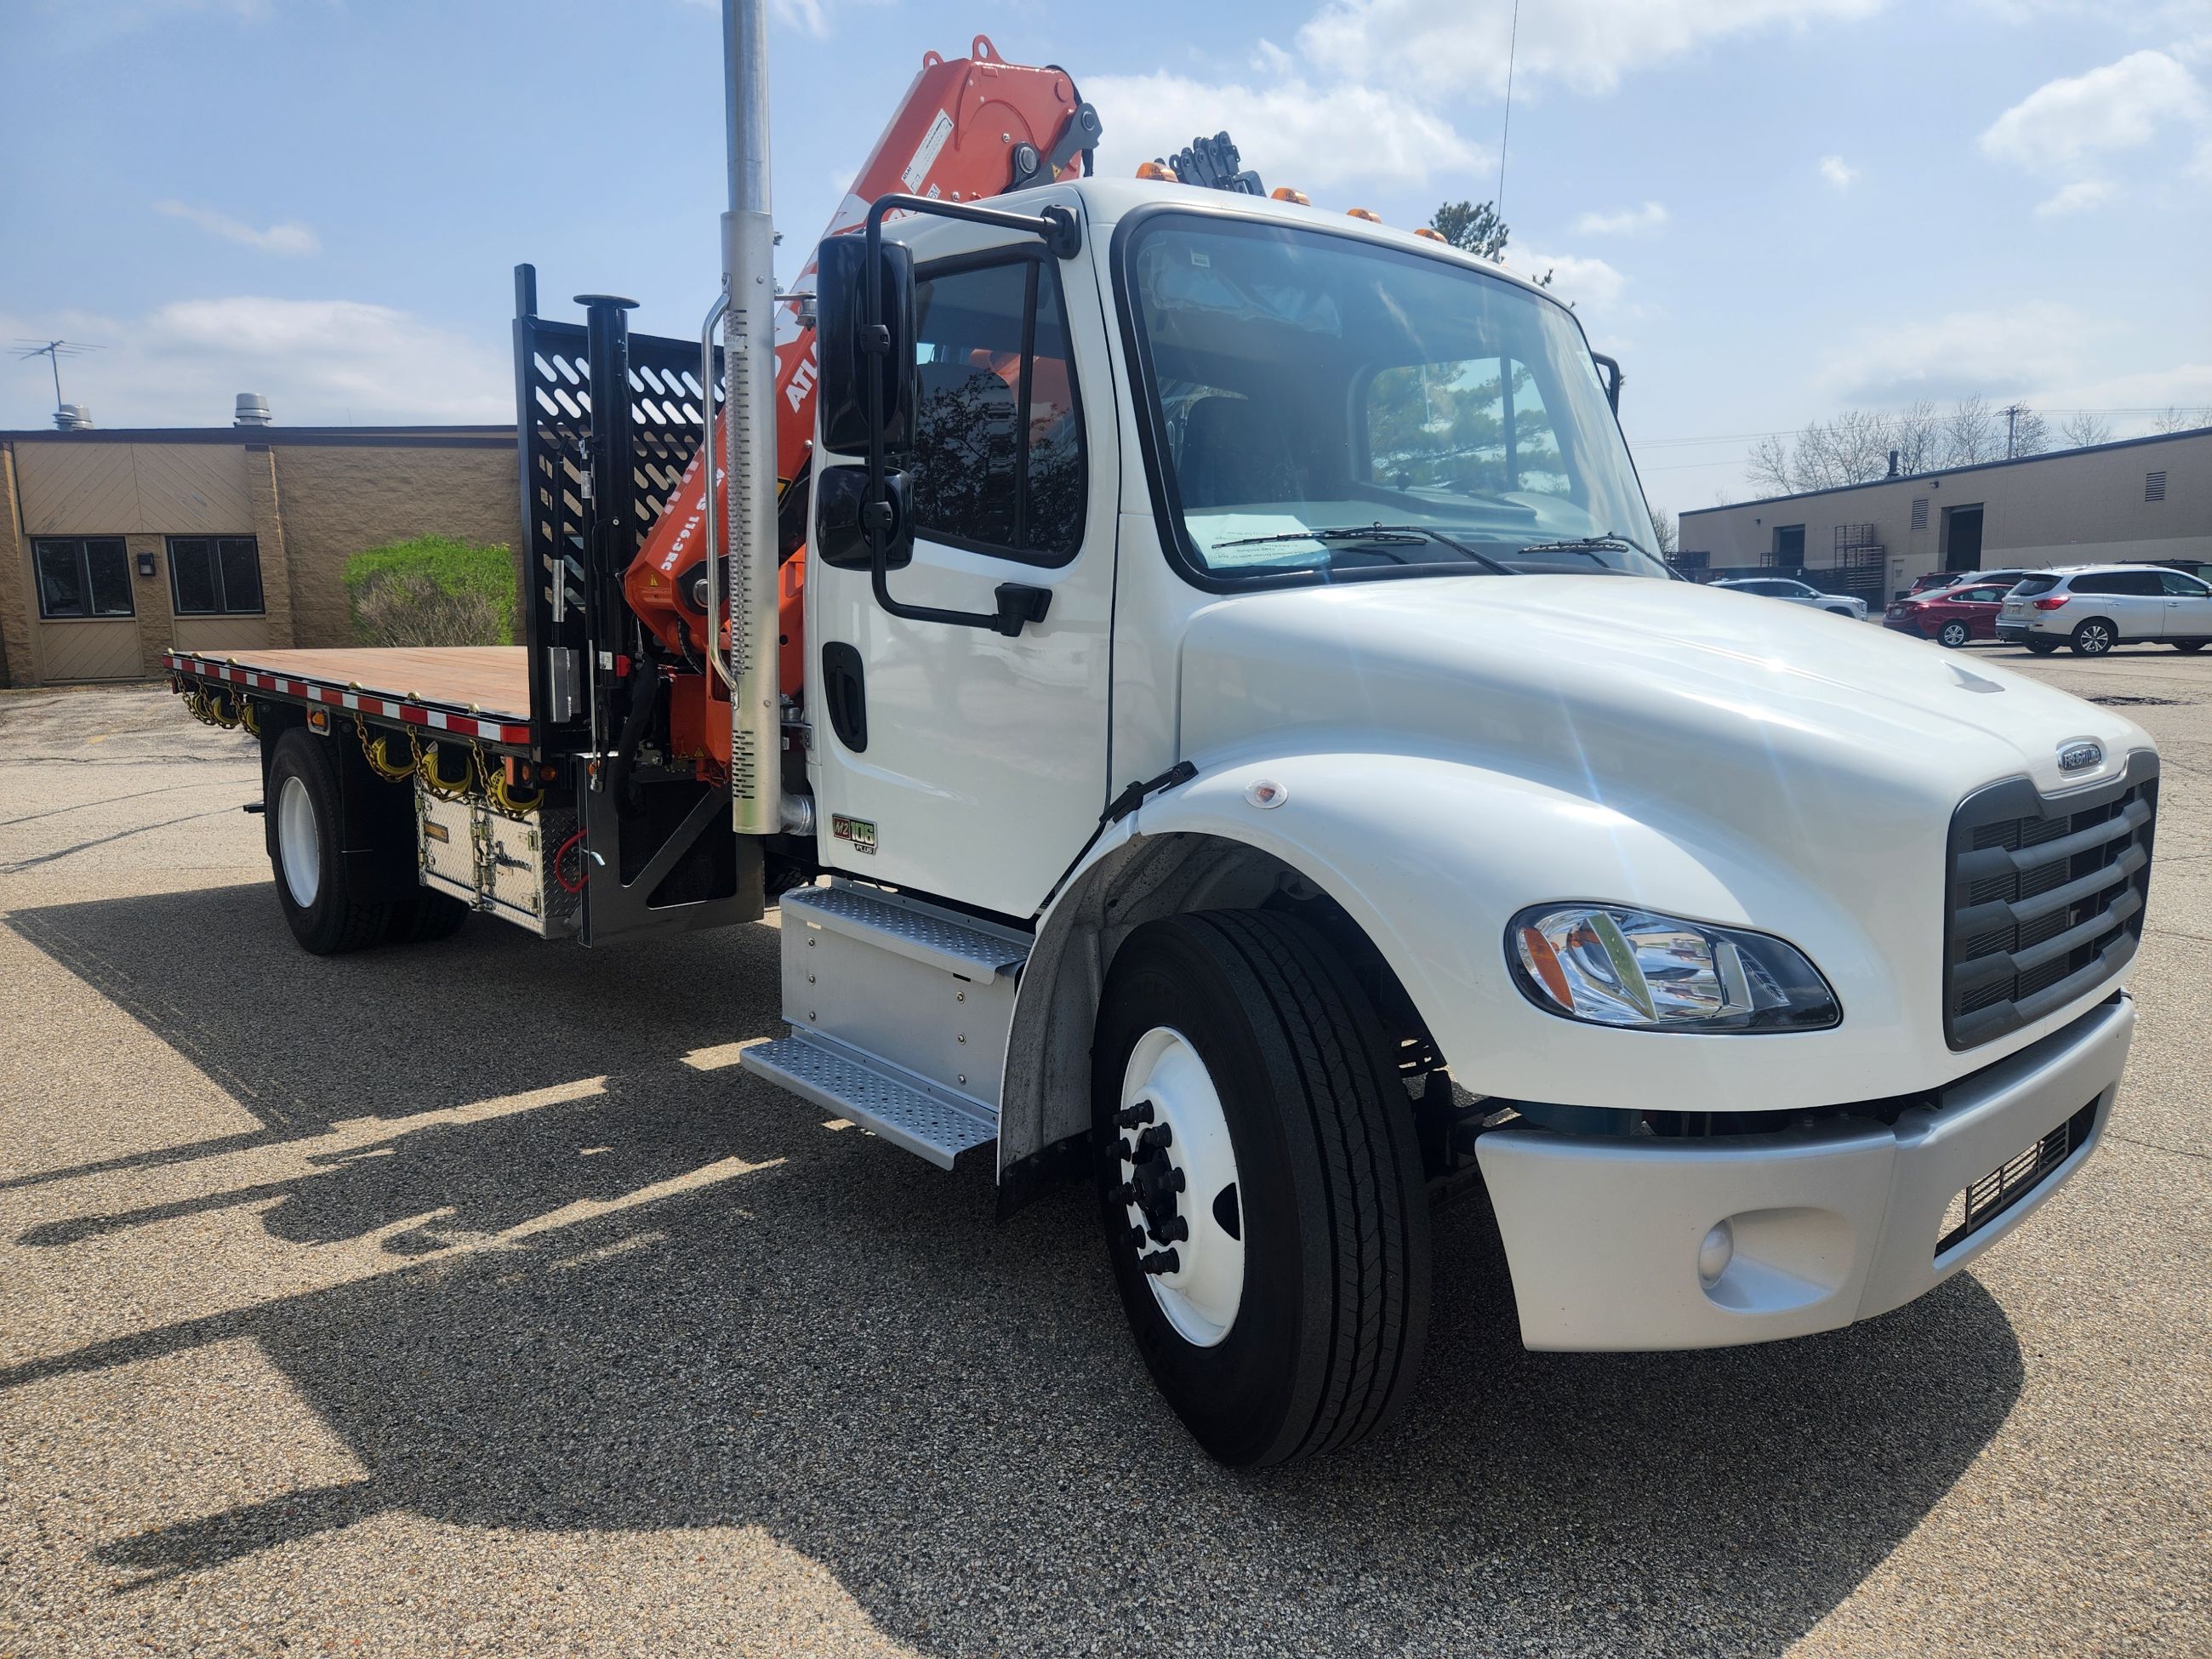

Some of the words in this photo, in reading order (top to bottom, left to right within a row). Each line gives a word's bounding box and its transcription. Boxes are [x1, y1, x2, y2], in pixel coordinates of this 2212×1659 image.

[903, 166, 912, 180] ATLAS
[785, 342, 818, 414] ATL
[660, 516, 700, 571] 116.3RC
[835, 822, 849, 835] M2
[850, 821, 875, 845] 106
[856, 845, 873, 854] PLUS
